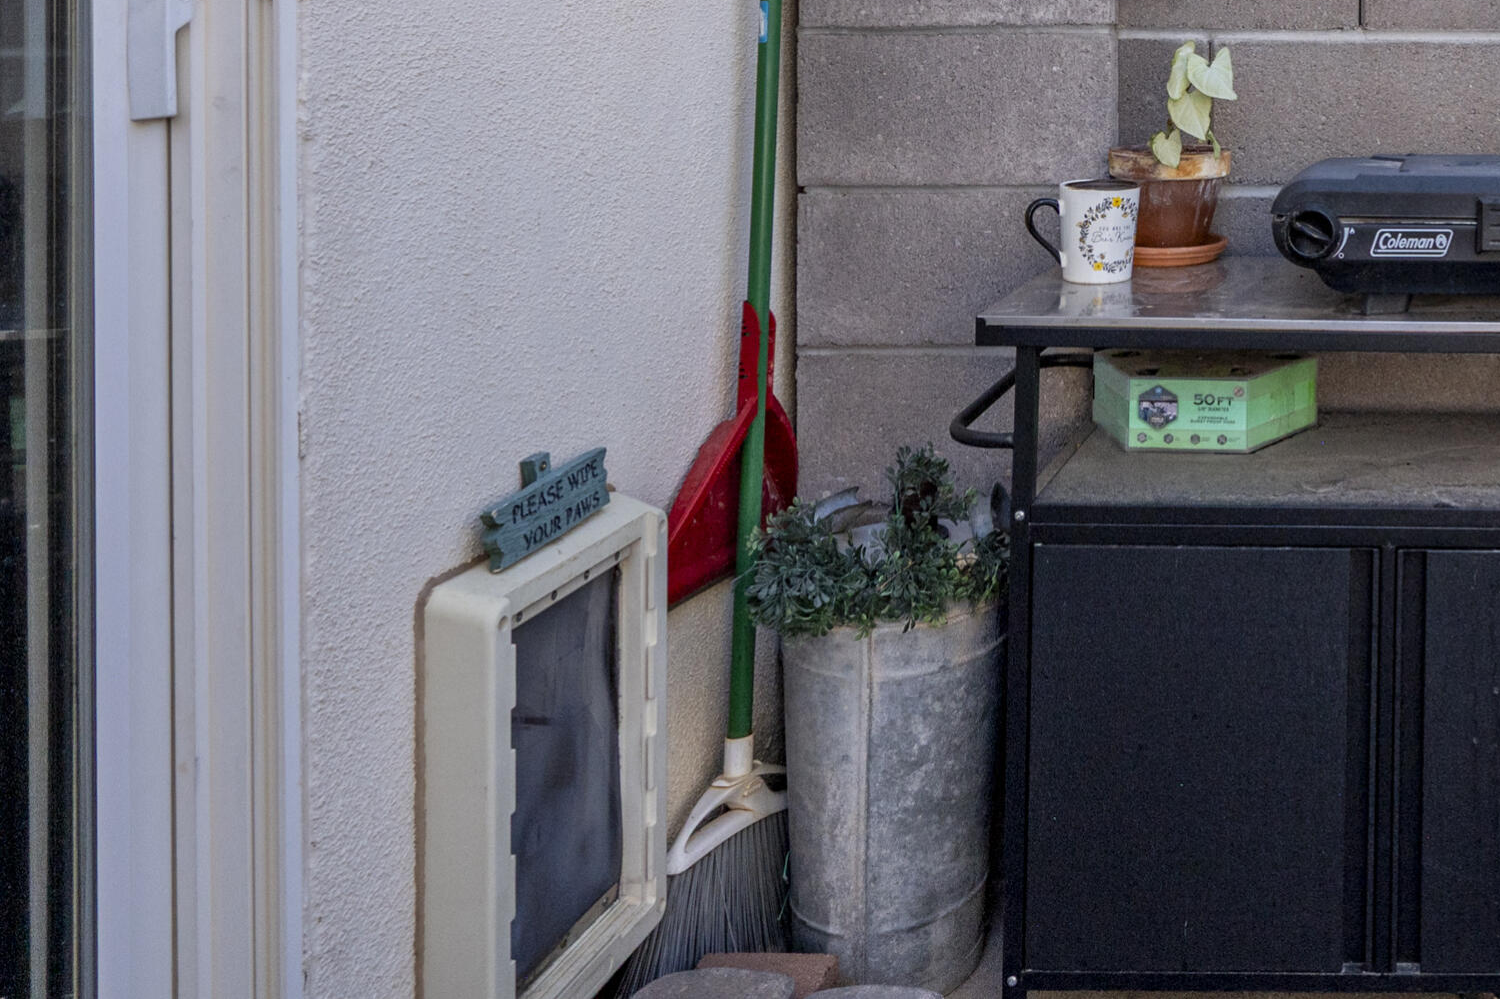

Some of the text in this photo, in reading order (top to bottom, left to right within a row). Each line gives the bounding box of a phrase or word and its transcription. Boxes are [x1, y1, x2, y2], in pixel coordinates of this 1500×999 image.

[1379, 232, 1434, 250] Coleman
[511, 458, 598, 524] PLEASE WIPE
[522, 490, 600, 551] YOUR PAWS
